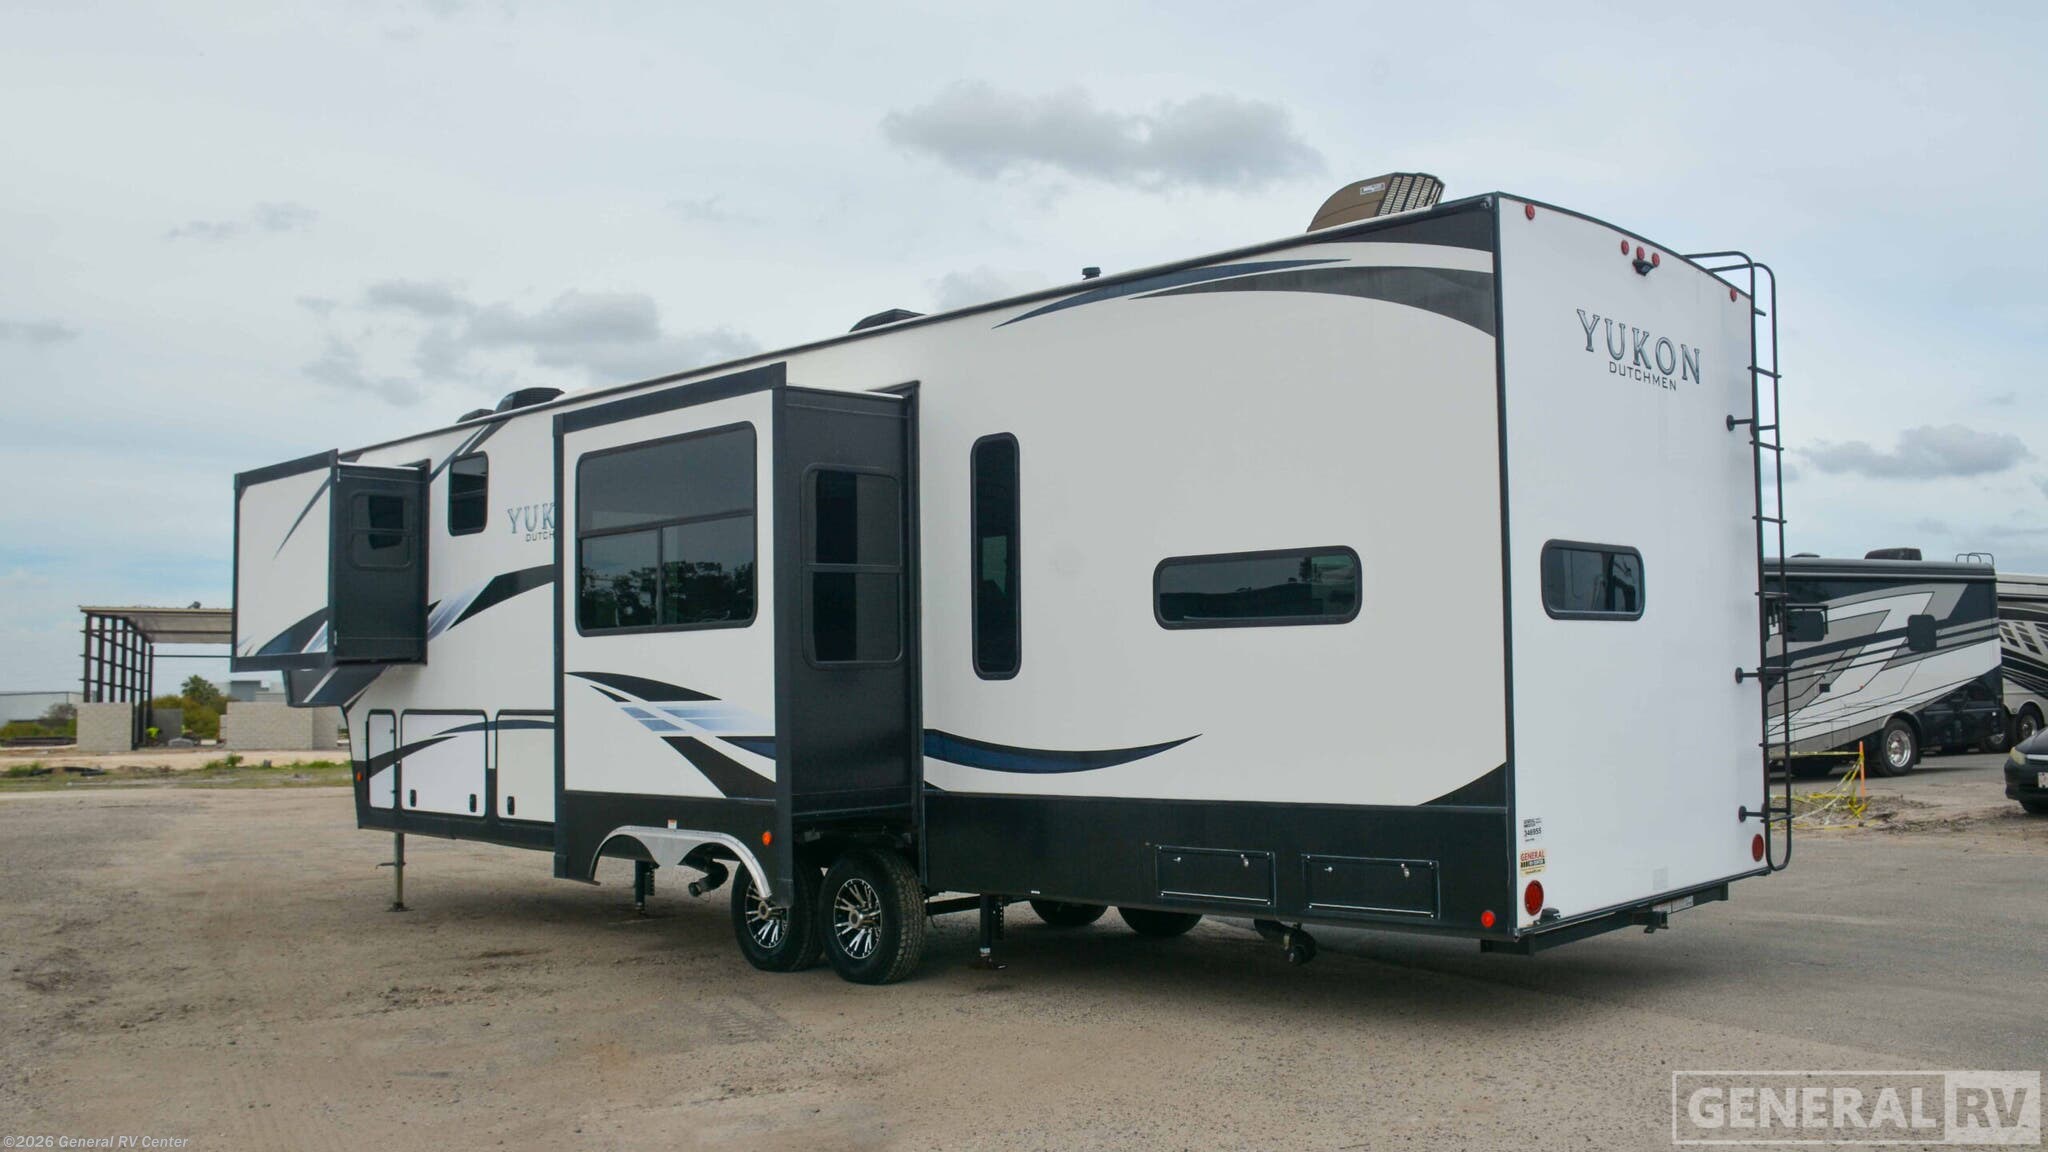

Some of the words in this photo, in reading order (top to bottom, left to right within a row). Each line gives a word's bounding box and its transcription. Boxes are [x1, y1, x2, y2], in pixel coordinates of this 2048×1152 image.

[1576, 308, 1700, 385] YUKON
[1609, 361, 1677, 391] DUTCHMEN
[507, 502, 555, 534] YUK
[1520, 850, 1544, 861] GENERAL
